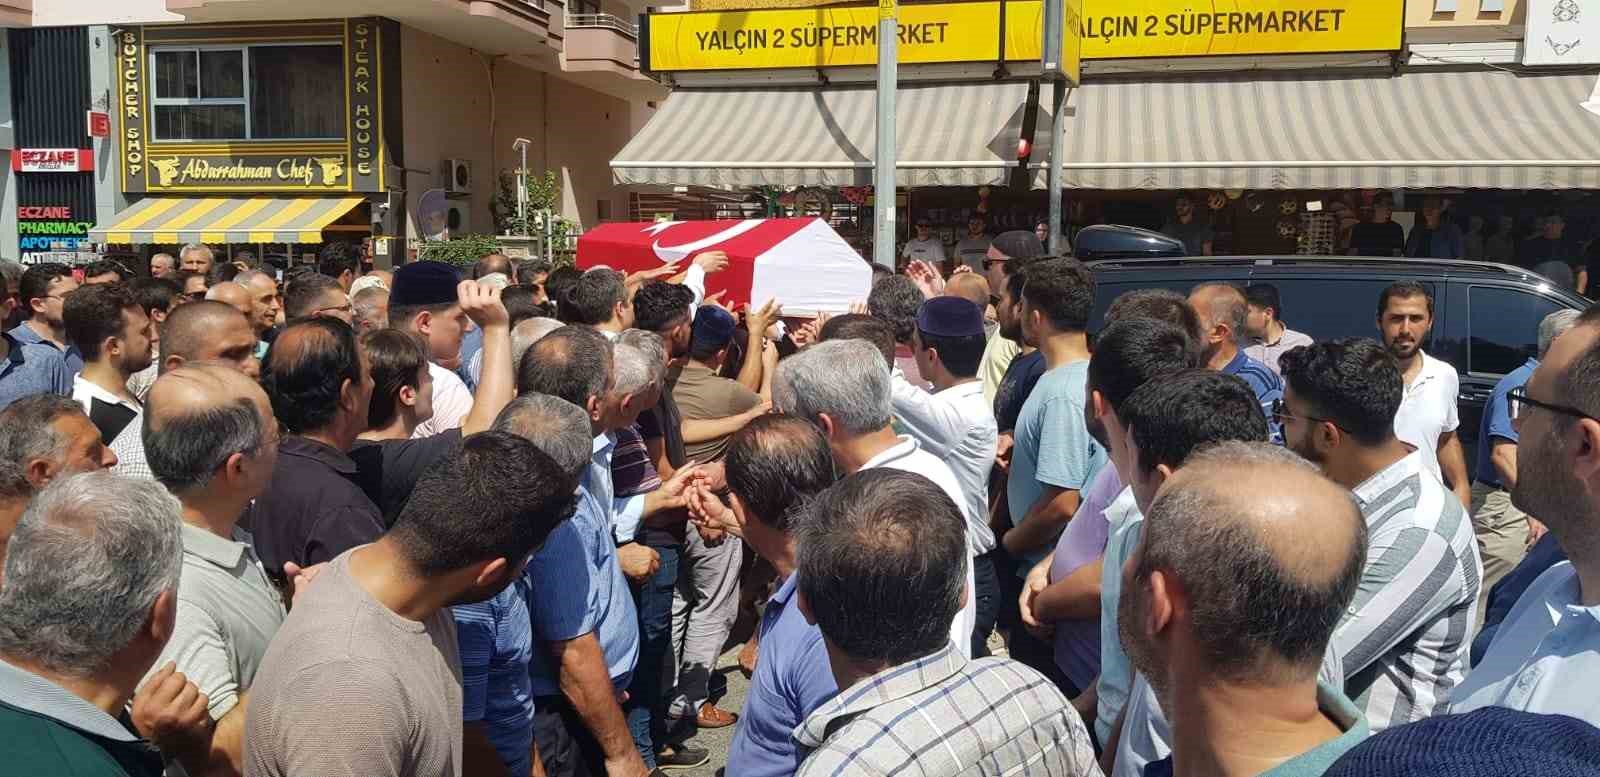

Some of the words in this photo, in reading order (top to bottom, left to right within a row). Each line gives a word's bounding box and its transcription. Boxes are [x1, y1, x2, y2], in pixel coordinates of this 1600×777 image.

[695, 28, 767, 55] YALÇIN
[773, 28, 785, 48] 2
[790, 22, 949, 48] SÜPERMRKET
[1144, 16, 1158, 37] 2
[1163, 8, 1345, 36] SÜPERMARKET
[355, 23, 370, 93] STEAK
[124, 32, 139, 118] BUTCHER
[127, 127, 142, 176] SHOP
[355, 104, 371, 174] HOUSE
[179, 158, 272, 184] Abdurrahman
[276, 157, 314, 187] Chef
[18, 206, 71, 219] ECZANE
[18, 222, 93, 235] PHARMACY
